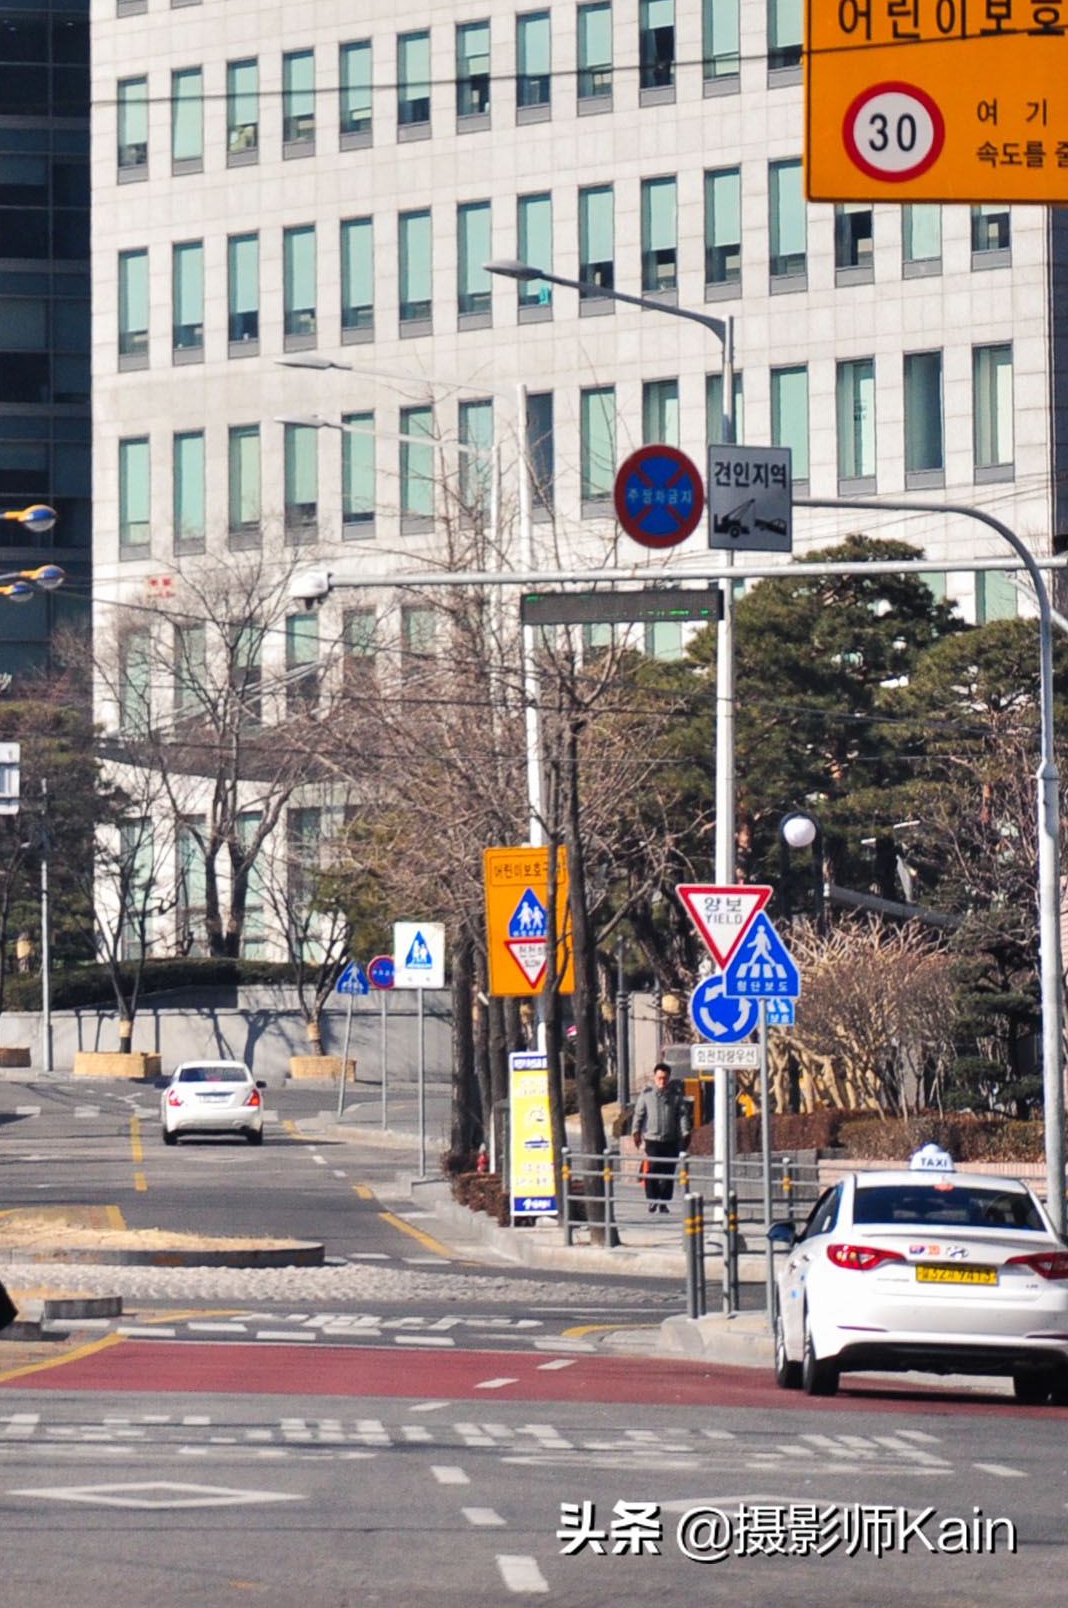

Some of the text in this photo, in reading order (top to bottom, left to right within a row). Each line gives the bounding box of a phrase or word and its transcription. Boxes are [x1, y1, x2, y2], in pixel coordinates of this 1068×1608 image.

[867, 112, 918, 153] 30
[975, 140, 1047, 169] 속도를
[713, 460, 787, 490] 견인지역
[703, 895, 743, 913] 양보
[706, 913, 743, 926] YIELD
[735, 980, 789, 993] 횡단보도
[920, 1157, 948, 1168] TAXI
